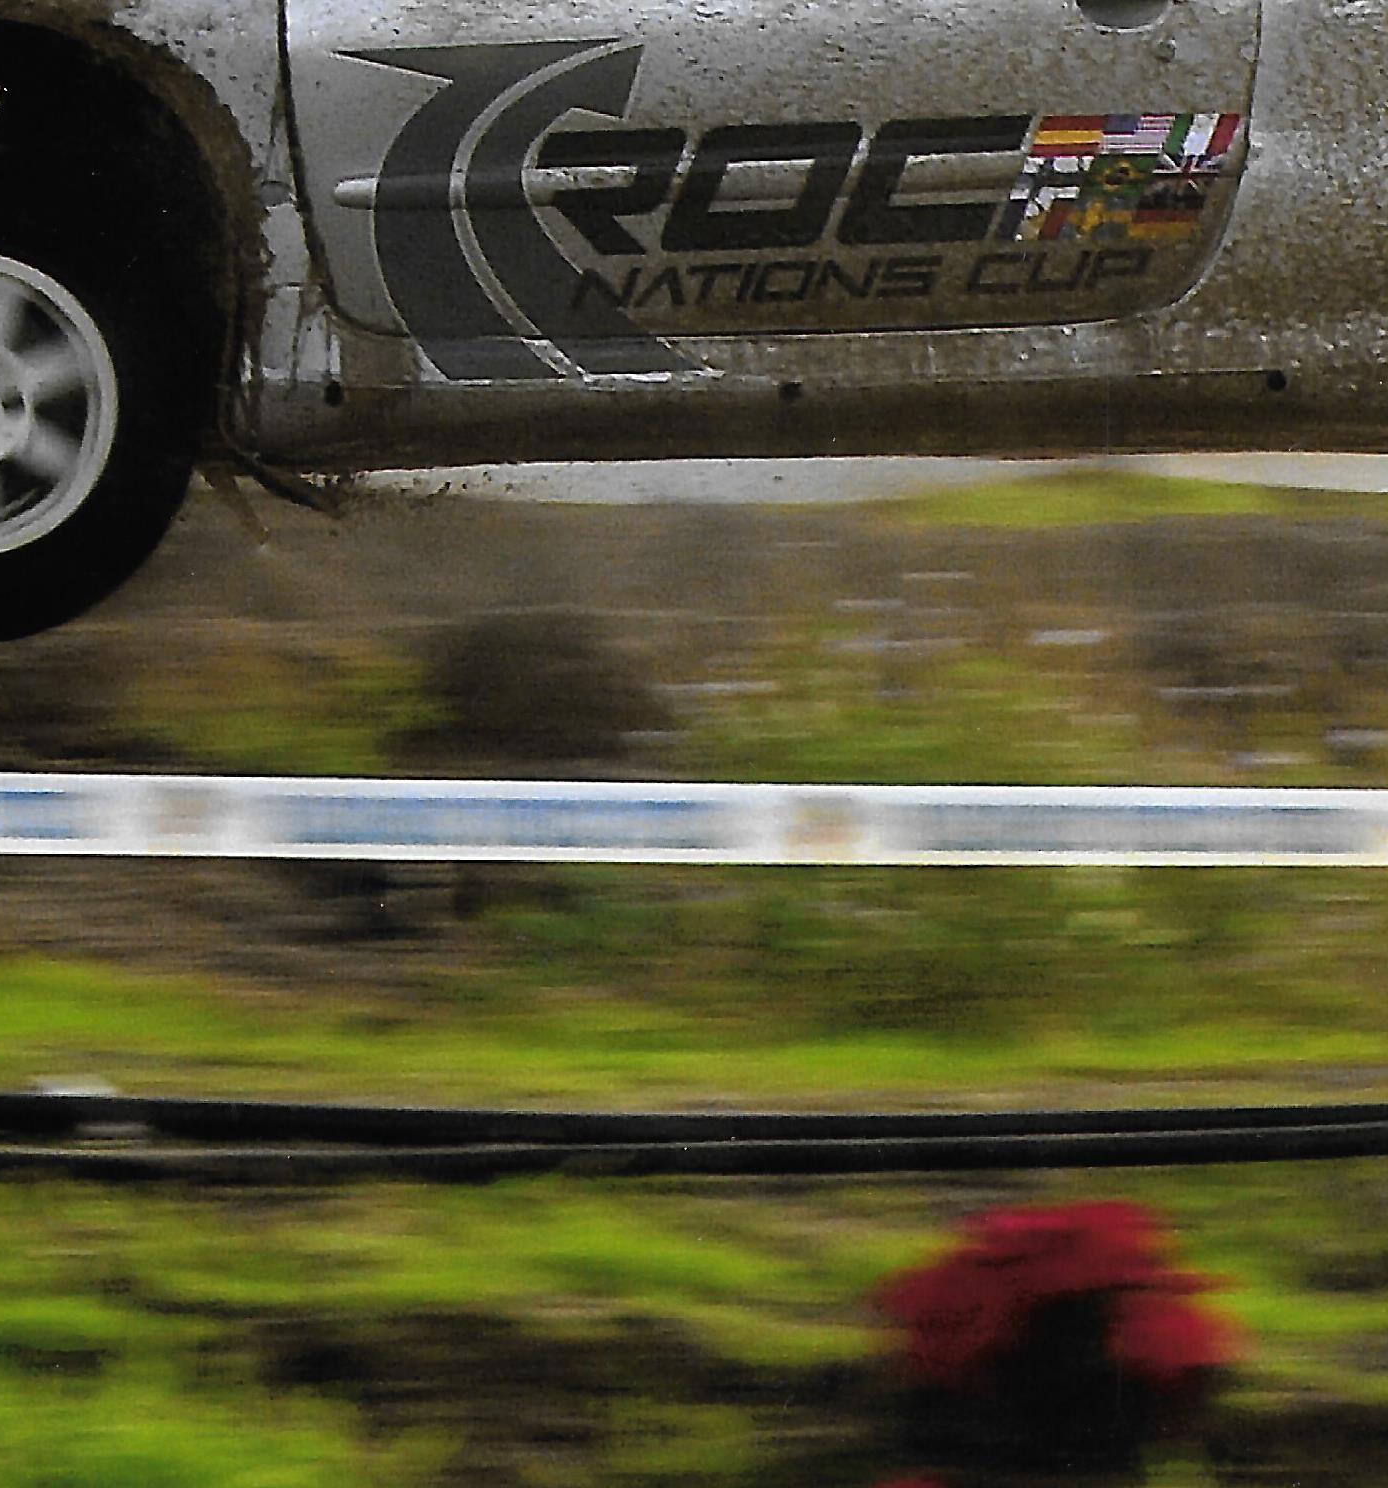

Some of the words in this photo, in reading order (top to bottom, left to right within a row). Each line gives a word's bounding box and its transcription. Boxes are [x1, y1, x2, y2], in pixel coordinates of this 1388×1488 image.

[534, 114, 1032, 256] ROC
[568, 254, 943, 310] NATIONS
[964, 246, 1157, 295] CUP
